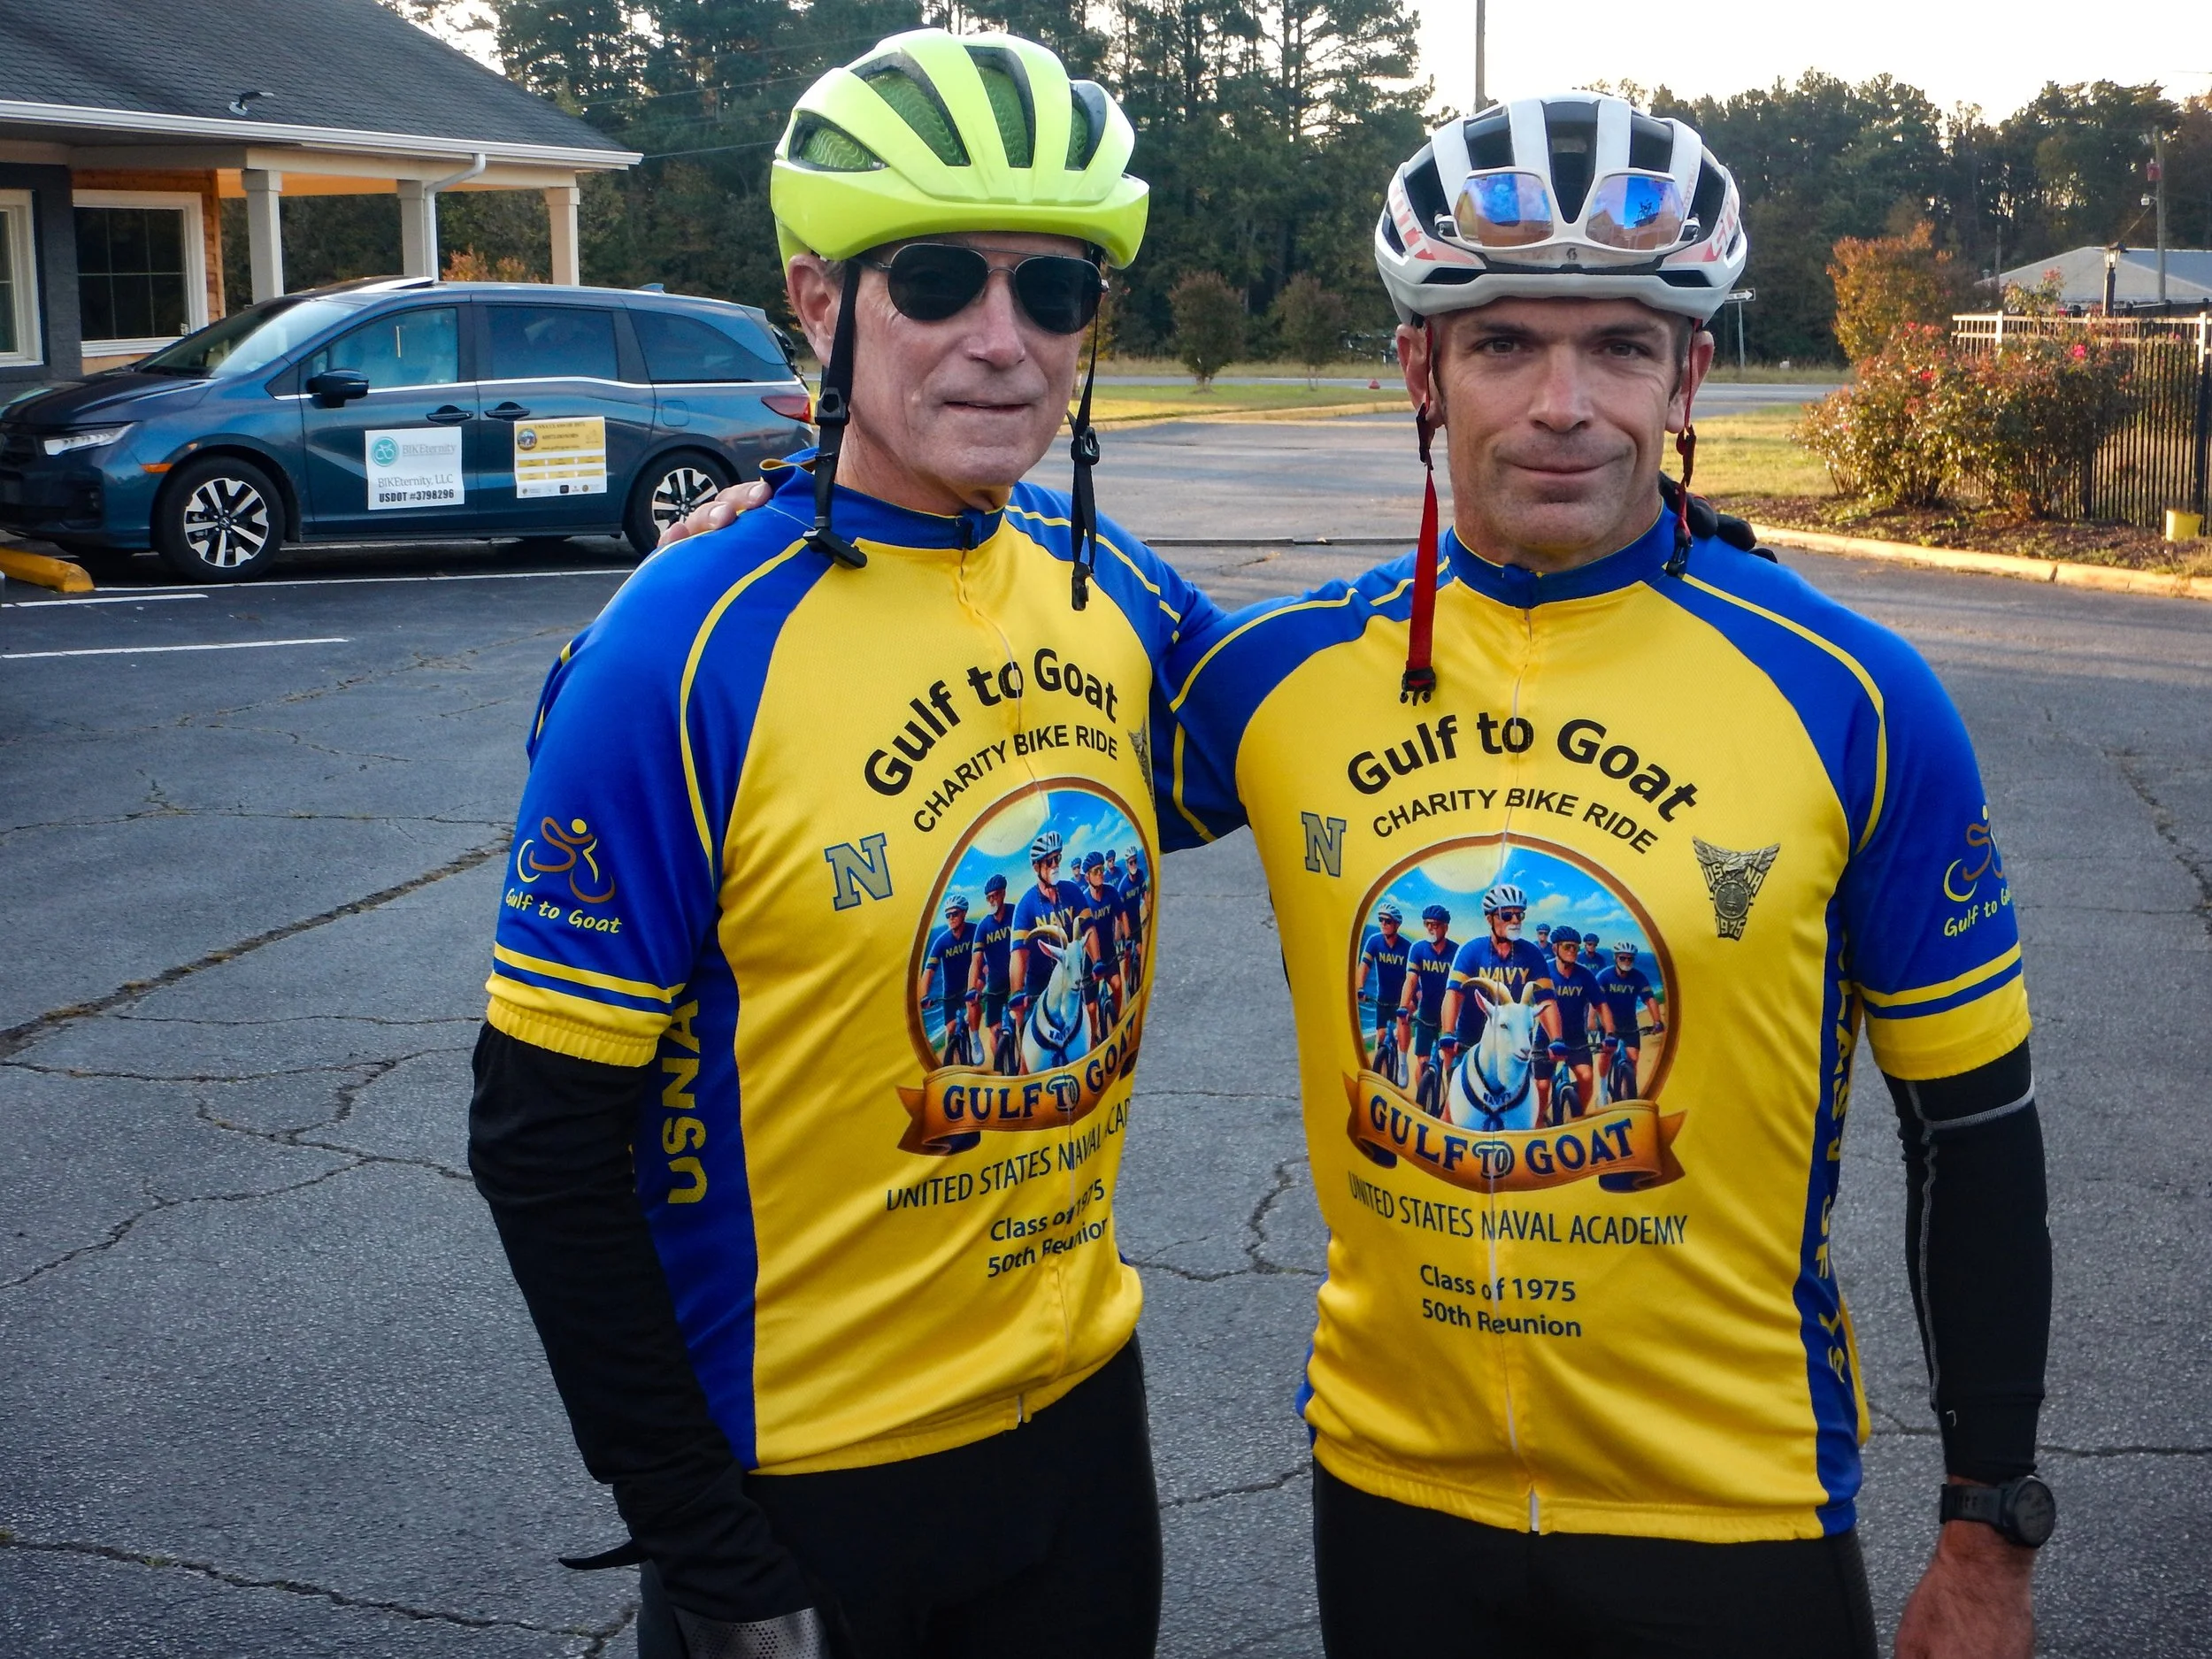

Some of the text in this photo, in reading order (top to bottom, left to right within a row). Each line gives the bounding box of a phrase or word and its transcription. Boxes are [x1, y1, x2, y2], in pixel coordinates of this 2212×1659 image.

[379, 489, 454, 503] USDOT #3798296
[434, 473, 454, 485] LLC
[864, 648, 1118, 796] Gulf to Goat
[913, 724, 1118, 833] CHARITY BIKE RIDE
[1348, 711, 1700, 823] Gulf to Goat
[1301, 810, 1347, 878] N
[1372, 787, 1659, 855] CHARITY BIKE RIDE
[824, 832, 894, 911] N
[505, 887, 622, 933] Gulf to Goat
[1944, 904, 1979, 937] Gulf
[1984, 900, 1998, 918] to
[945, 941, 971, 958] NAVY
[1379, 952, 1405, 966] NAVY
[1479, 966, 1530, 985] NAVY
[1609, 983, 1635, 995] NAVY
[662, 999, 708, 1204] USNA
[943, 1081, 1042, 1121] GULF
[1370, 1094, 1635, 1180] GULF TO GOAT
[887, 1171, 973, 1211] UNITED
[979, 1146, 1051, 1199] STATES
[1058, 1122, 1102, 1172] NAVAL
[990, 1216, 1048, 1242] Class
[1076, 1178, 1105, 1217] 1975
[1348, 1171, 1688, 1245] UNITED STATES NAVAL ACADEMY
[987, 1245, 1036, 1279] 50th
[1419, 1263, 1577, 1303] Class of 1975
[1421, 1298, 1582, 1338] 50th Reunion
